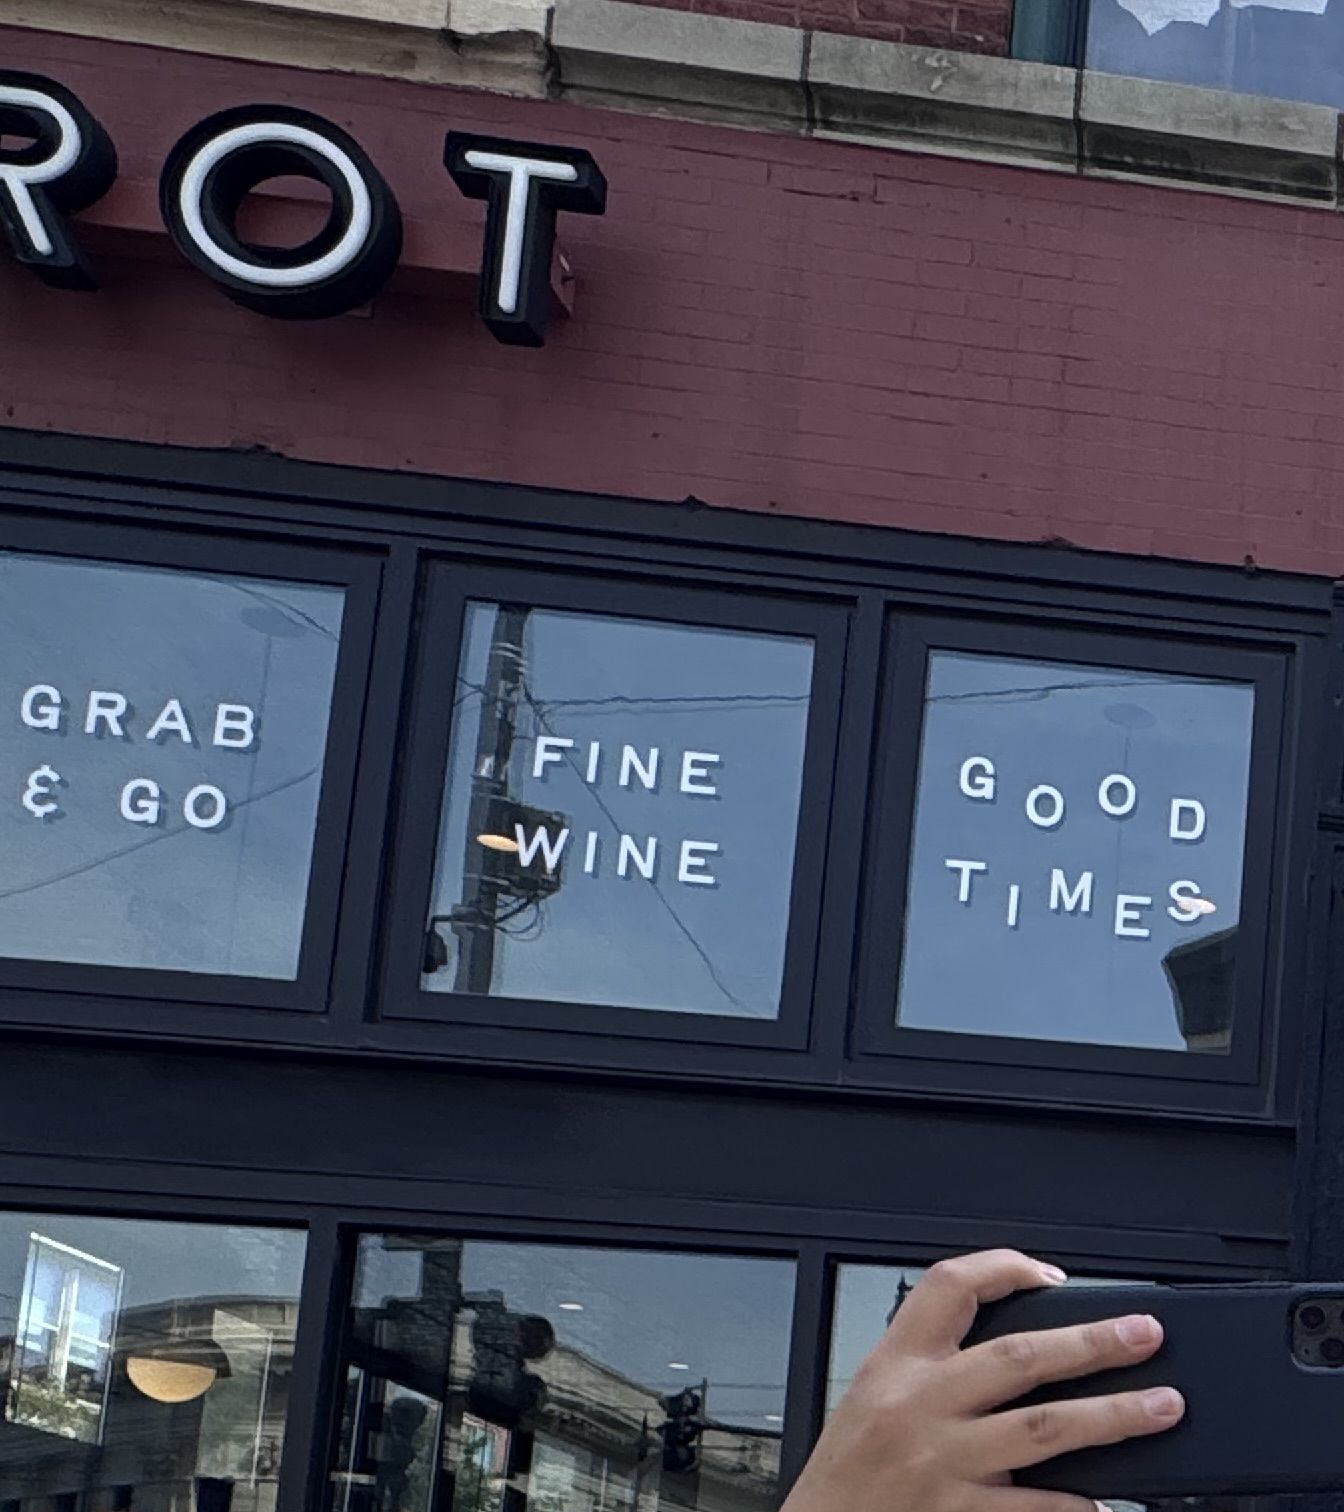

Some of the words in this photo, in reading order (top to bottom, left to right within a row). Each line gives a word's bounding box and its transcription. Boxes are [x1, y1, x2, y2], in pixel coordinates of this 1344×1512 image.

[20, 684, 256, 749] GRAB
[22, 765, 61, 818] &
[119, 778, 227, 829] GO
[532, 735, 720, 795] FINE
[959, 756, 1206, 840] GOOD
[514, 822, 719, 885] WINE
[945, 859, 1203, 938] TIMES
